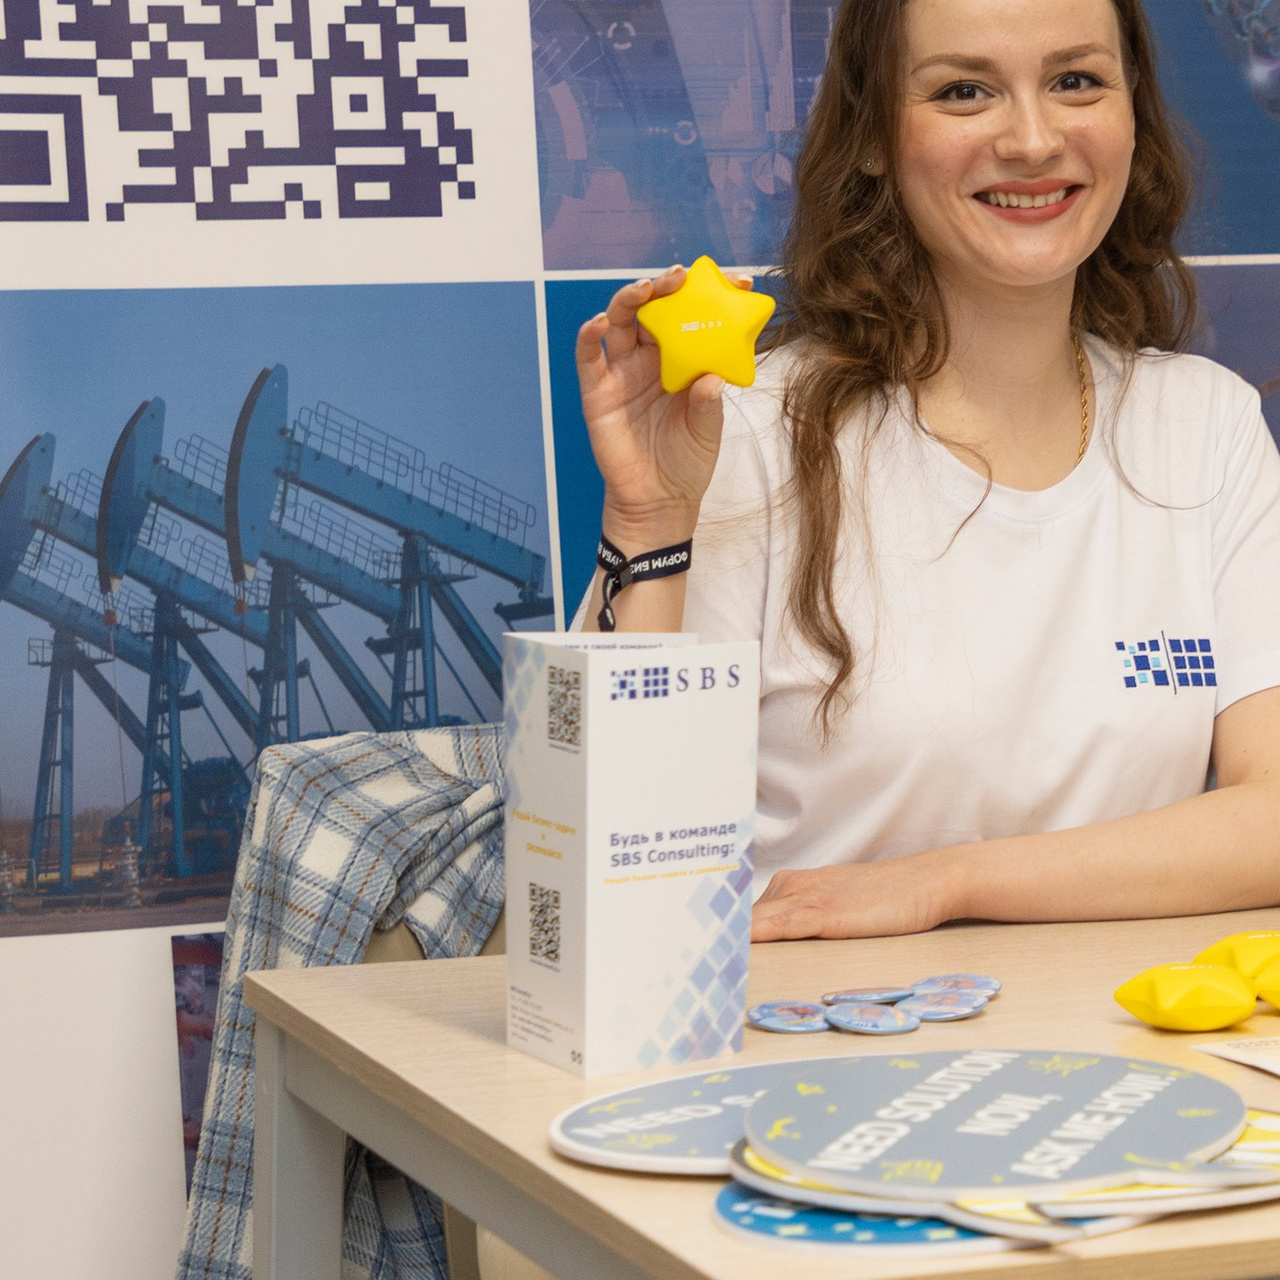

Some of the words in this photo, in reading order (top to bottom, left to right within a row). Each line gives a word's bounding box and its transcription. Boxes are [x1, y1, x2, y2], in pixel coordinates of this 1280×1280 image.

[652, 551, 688, 570] ФОРУМ
[677, 664, 740, 692] SBS
[610, 833, 649, 848] Будь
[655, 832, 664, 842] в
[669, 822, 737, 841] команде
[610, 852, 642, 868] SBS
[647, 842, 735, 863] Consulting:
[806, 1121, 911, 1173] NEED
[875, 1050, 1021, 1122] SOLUTION
[1050, 1112, 1126, 1141] ME
[1010, 1138, 1096, 1181] ASK
